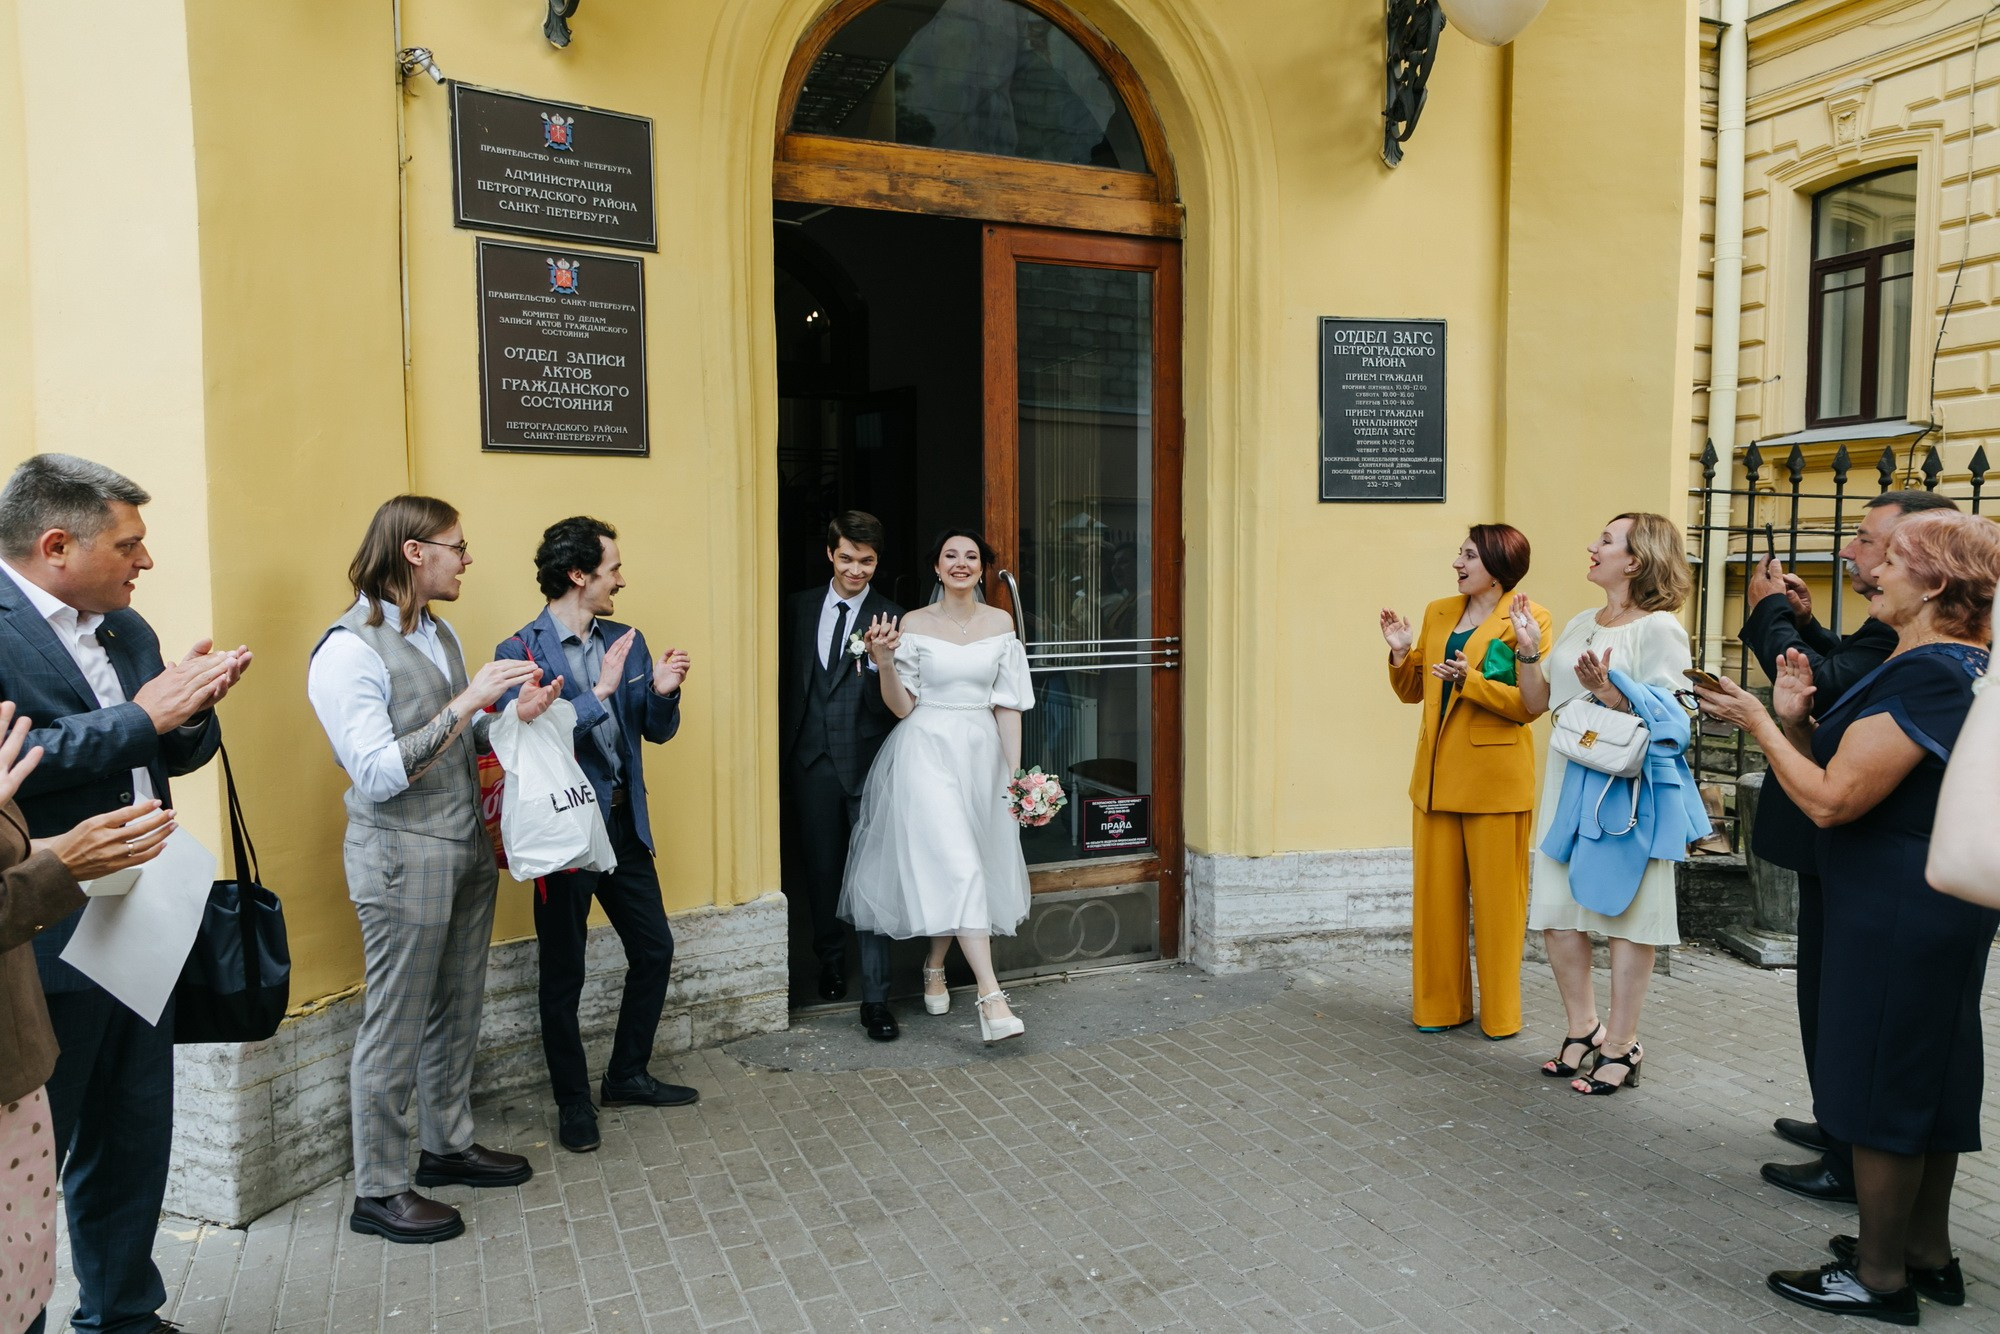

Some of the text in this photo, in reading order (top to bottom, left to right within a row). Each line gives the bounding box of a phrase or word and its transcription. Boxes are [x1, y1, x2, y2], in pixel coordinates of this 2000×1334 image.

[481, 144, 632, 175] ПРАВИТЕЛЬСТВО САНКТ-ПЕТЕРБУРГА
[505, 168, 612, 193] АДМИНИСТРАЦИЯ
[477, 180, 638, 212] ПЕТРОГРАДСКОГО РАЙОНА
[499, 200, 619, 225] САНКТ-ПЕТЕРБУРГА
[488, 290, 636, 312] ПРАВИТЕЛЬСТВО САНКТ-ПЕТЕРБУРГА
[522, 310, 559, 320] КОМИТЕТ
[579, 315, 606, 324] ДЕЛАМ
[500, 317, 628, 334] ЗАПИСИ АКТОВ ГРАЖДАНСКОГО
[542, 329, 589, 338] СОСТОЯНИЯ
[1334, 330, 1432, 345] ОТДЕЛ ЗАГС
[504, 346, 625, 367] ОТДЕЛ ЗАПИСИ
[1333, 345, 1436, 357] ПЕТРОГРАДСКОГО
[1362, 357, 1406, 367] РАЙОНА
[542, 366, 592, 379] АКТОВ
[1380, 374, 1423, 382] ГРАЖДАН
[502, 378, 629, 397] ГРАЖДАНСКОГО
[521, 396, 613, 411] СОСТОЯНИЯ
[1379, 409, 1424, 418] ГРАЖДАН
[506, 421, 628, 433] ПЕТРОГРАДСКОГО РАЙОНА
[1352, 419, 1418, 427] НАЧАЛЬНИКОМ
[524, 431, 612, 442] САНКТ-ПЕТЕРБУРГА
[1354, 428, 1389, 437] ОТДЕЛА
[1101, 820, 1132, 830] ПРАЙД
